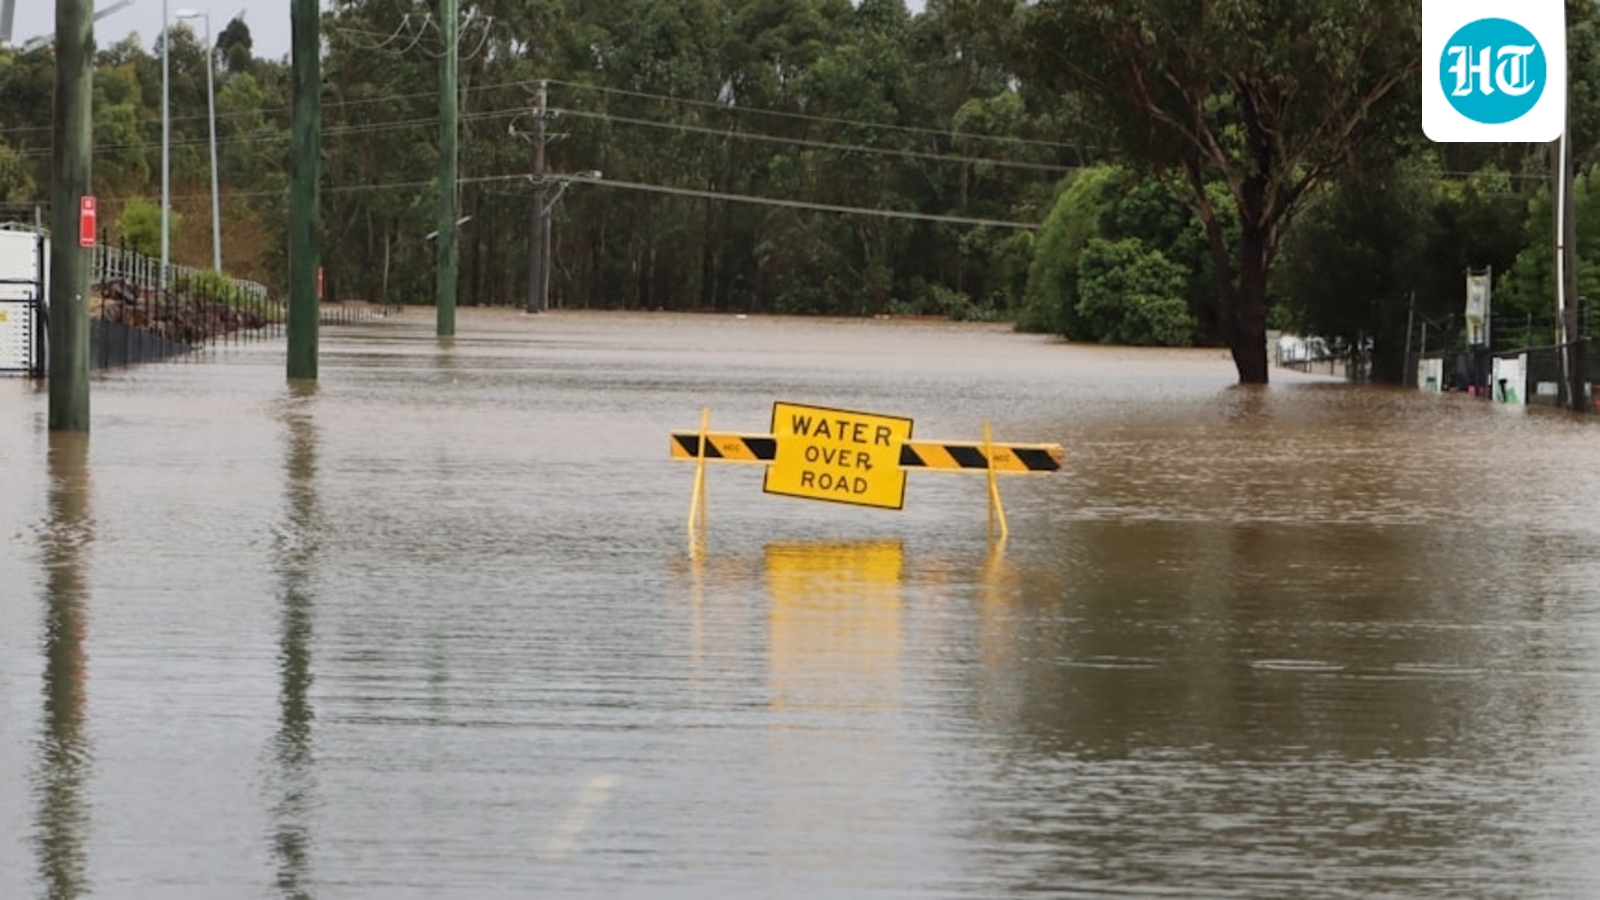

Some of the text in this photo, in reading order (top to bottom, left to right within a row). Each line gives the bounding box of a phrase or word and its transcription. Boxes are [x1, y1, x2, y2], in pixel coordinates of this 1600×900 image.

[792, 414, 892, 447] WATER
[804, 445, 871, 470] OVER
[801, 469, 868, 494] ROAD
